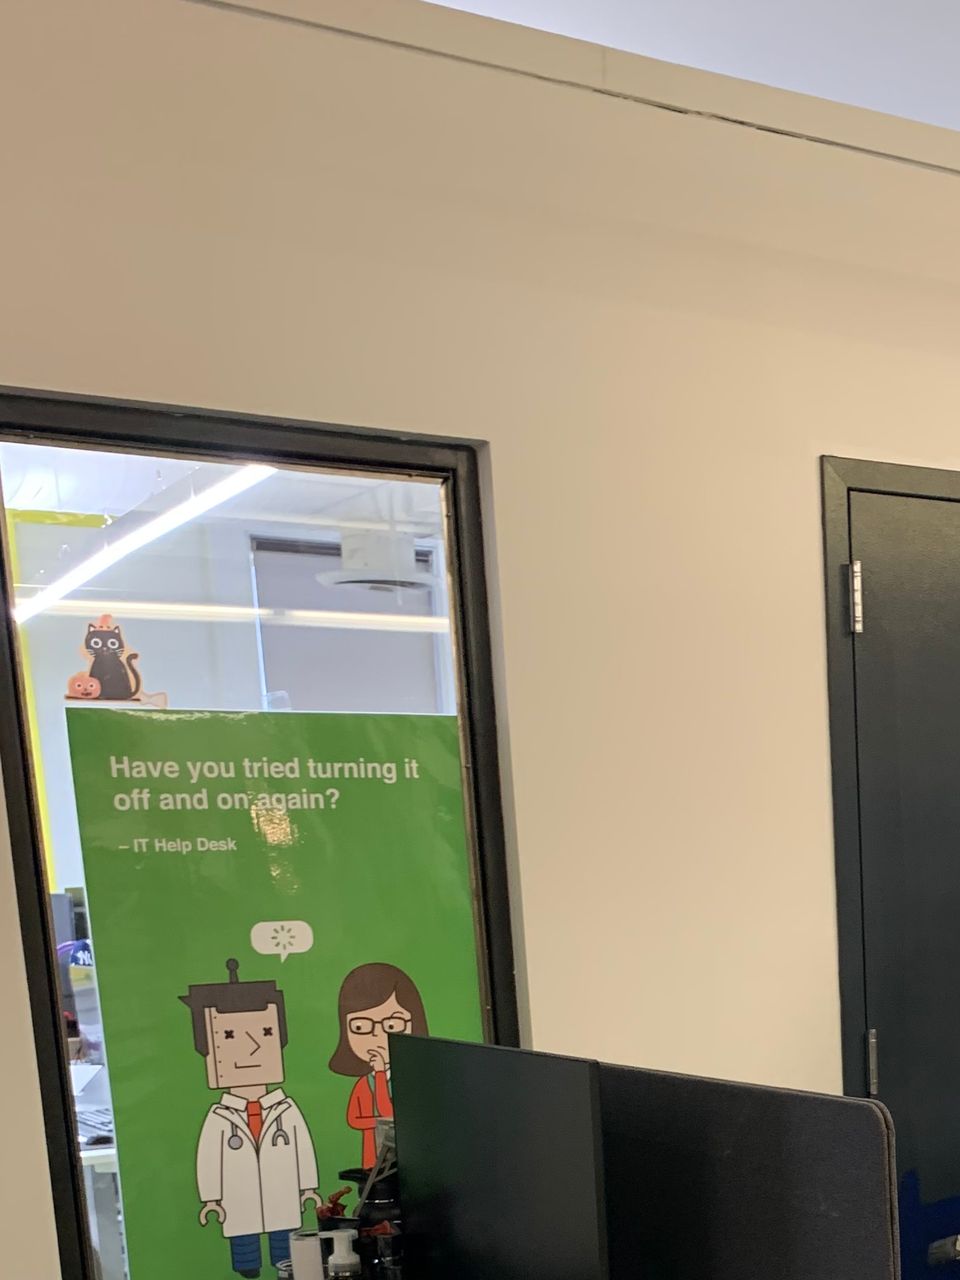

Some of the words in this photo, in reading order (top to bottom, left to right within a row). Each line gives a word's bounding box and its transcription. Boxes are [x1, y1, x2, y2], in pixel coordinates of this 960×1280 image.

[109, 755, 180, 778] Have
[186, 760, 236, 784] you
[242, 756, 300, 778] tried
[307, 757, 398, 784] turning
[404, 757, 419, 779] it
[113, 788, 151, 811] off
[159, 788, 209, 810] and
[216, 792, 249, 810] on
[256, 787, 340, 815] again?
[133, 838, 150, 853] IT
[154, 838, 193, 854] Help
[196, 837, 237, 852] Desk
